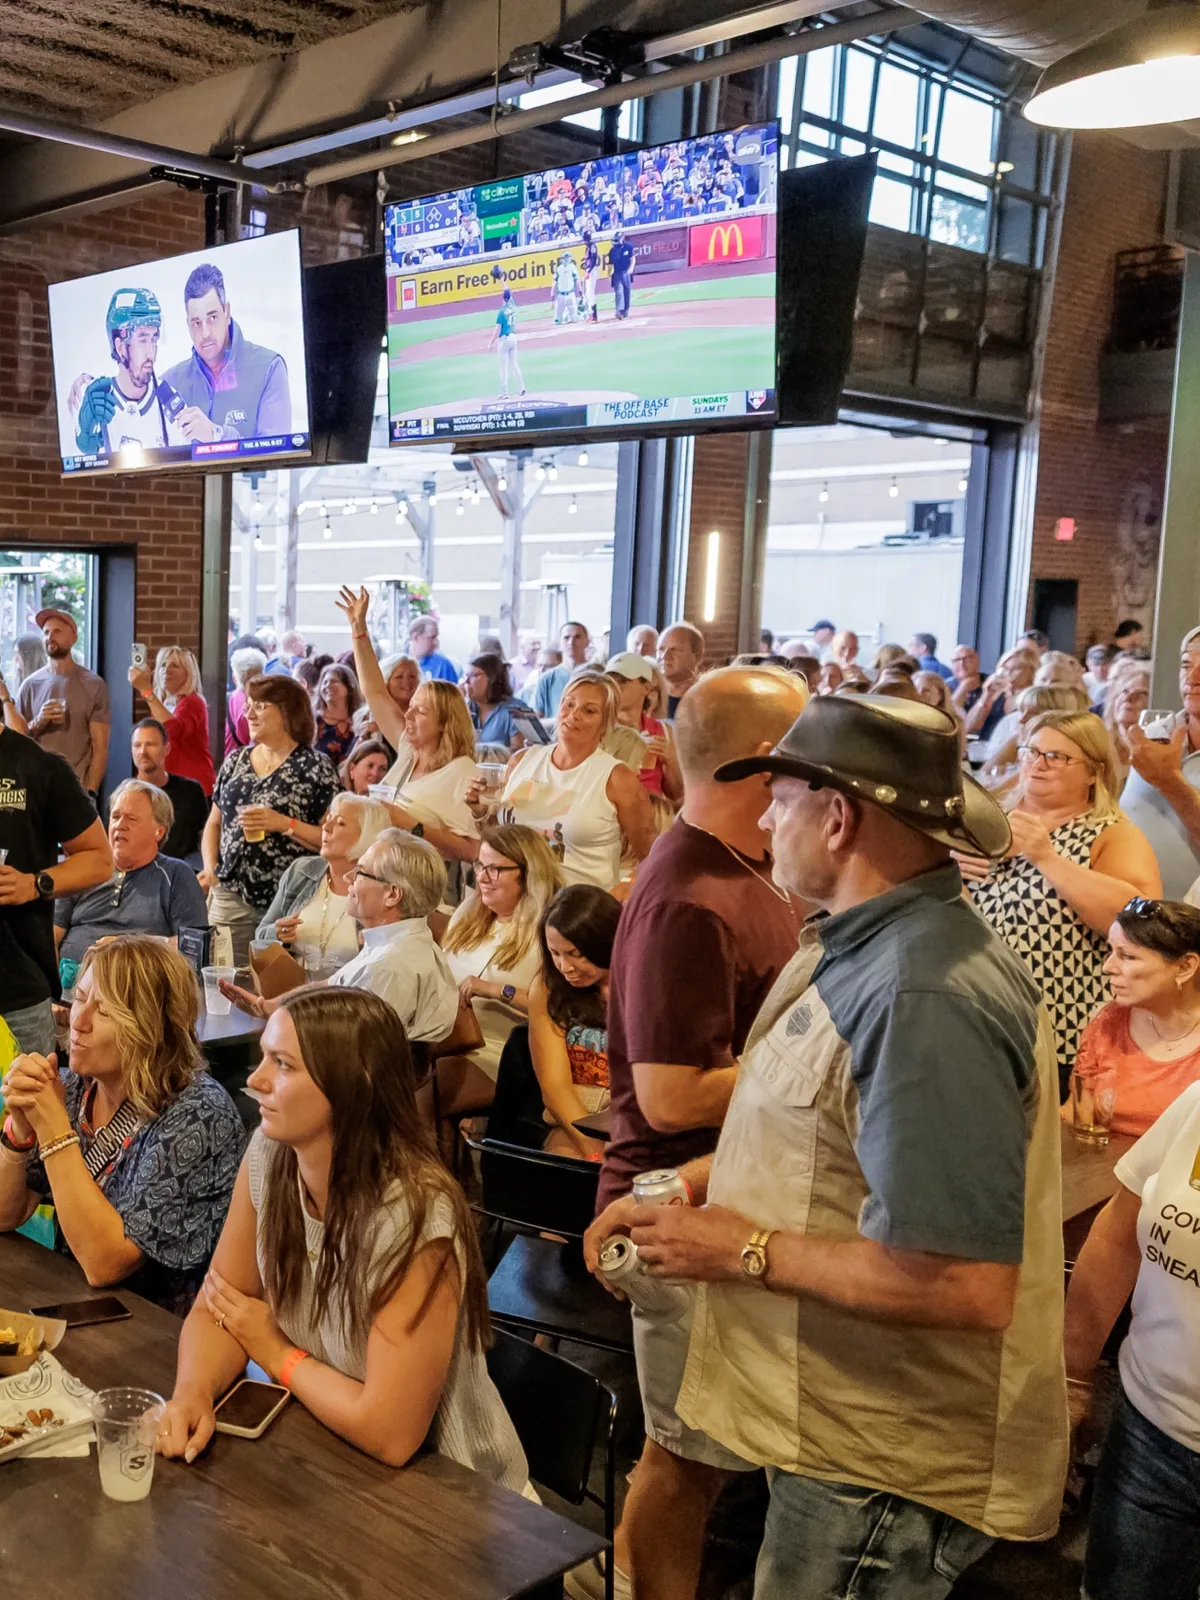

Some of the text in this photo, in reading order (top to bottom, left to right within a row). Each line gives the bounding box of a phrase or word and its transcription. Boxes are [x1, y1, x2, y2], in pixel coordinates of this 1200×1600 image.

[490, 185, 519, 197] clover
[414, 224, 421, 233] 6
[420, 276, 454, 296] Earn
[457, 267, 489, 289] Free
[531, 260, 546, 277] in
[604, 398, 670, 413] THE OFF BASE
[691, 395, 729, 406] SUNDAYS
[613, 408, 659, 420] PODCAST
[703, 405, 715, 414] AM
[717, 404, 727, 413] ET
[1150, 1222, 1172, 1246] IN
[128, 1454, 148, 1470] S
